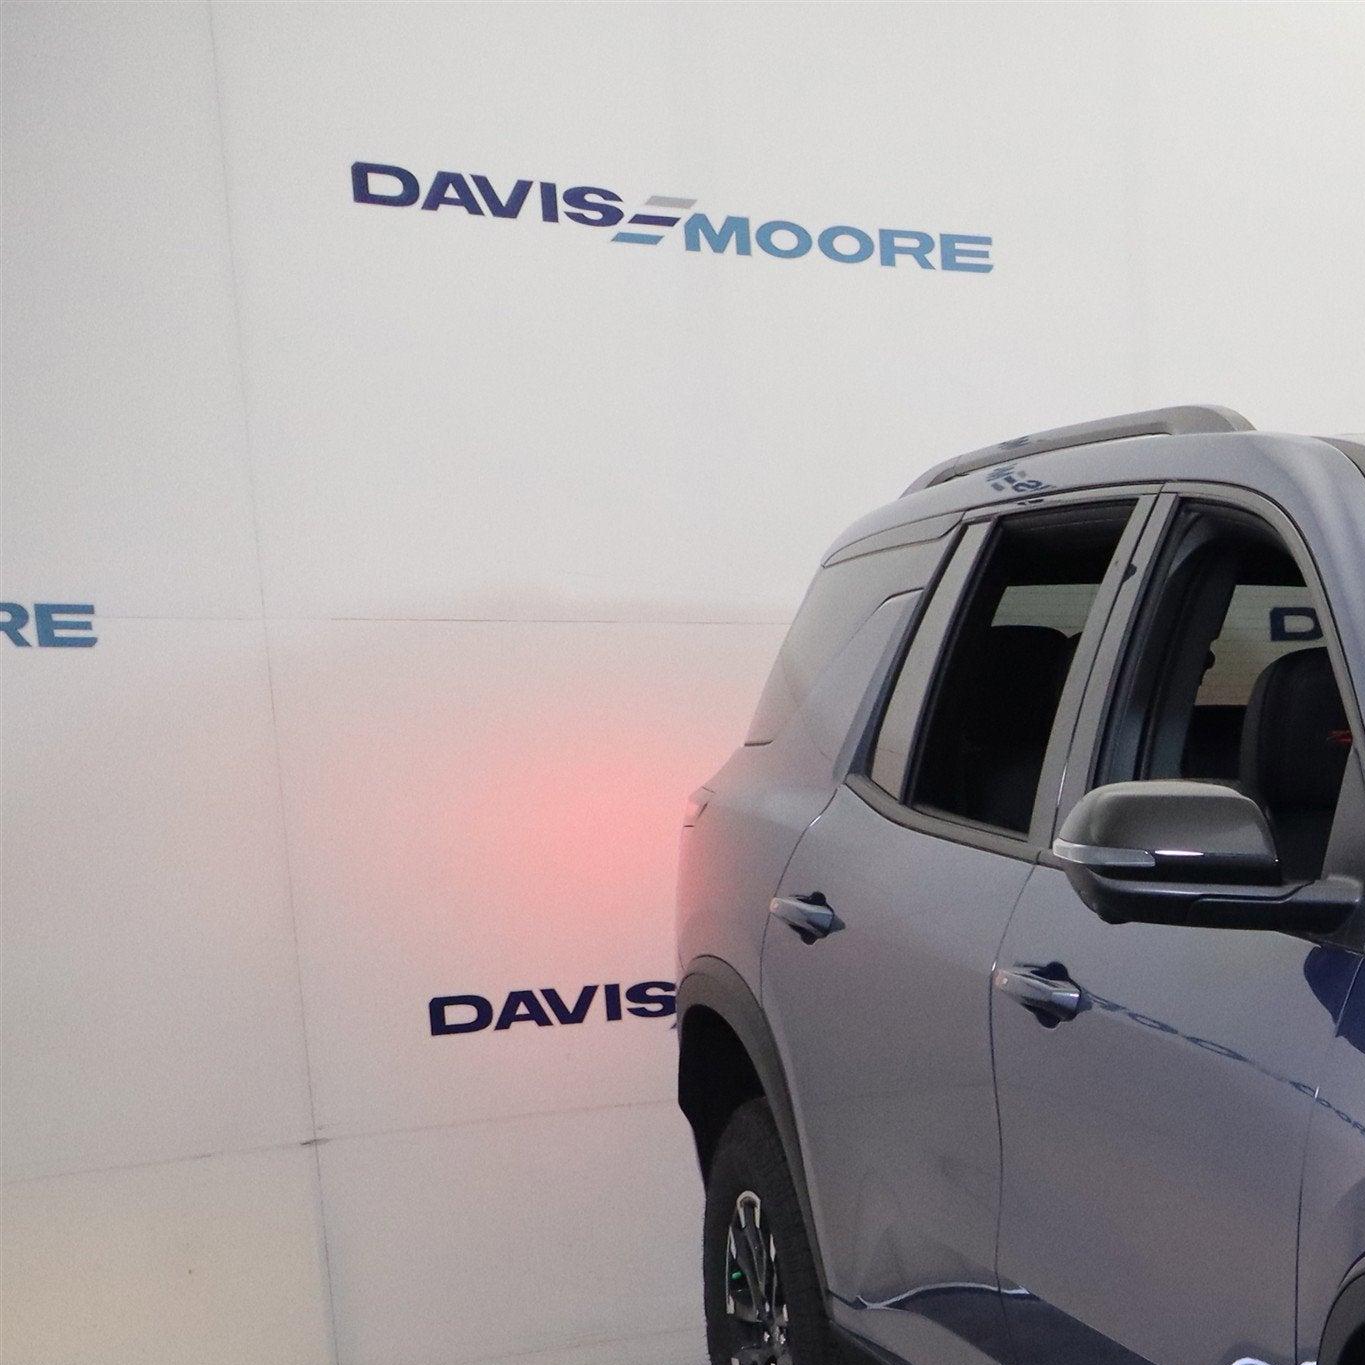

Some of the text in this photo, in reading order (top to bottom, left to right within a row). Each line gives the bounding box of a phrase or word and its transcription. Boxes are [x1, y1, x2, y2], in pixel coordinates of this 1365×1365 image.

[350, 160, 995, 274] DAVIS MOORE
[427, 980, 677, 1037] DAVIS
